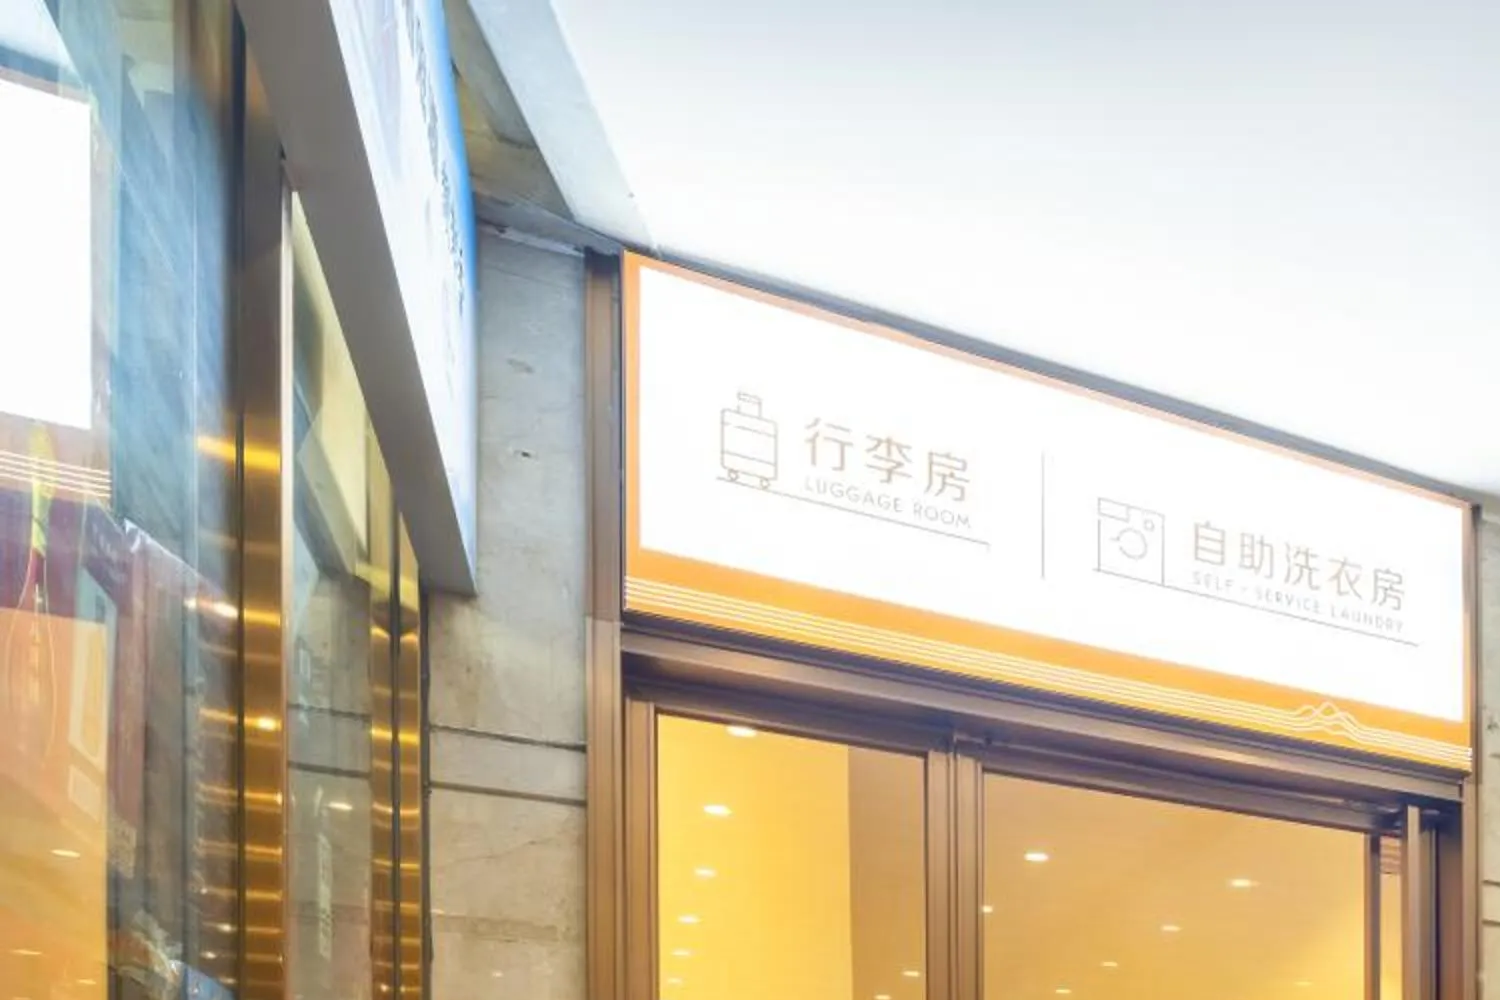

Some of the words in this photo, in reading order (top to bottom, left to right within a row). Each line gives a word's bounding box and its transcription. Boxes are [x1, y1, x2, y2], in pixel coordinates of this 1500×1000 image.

[805, 417, 970, 502] 行李房
[805, 475, 902, 514] LUGGAGE
[913, 502, 971, 529] ROOM
[1193, 520, 1405, 611] 自助洗衣房
[1193, 570, 1234, 592] SELF
[1255, 588, 1321, 614] SERVICE
[1330, 604, 1404, 633] LAUNDRY
